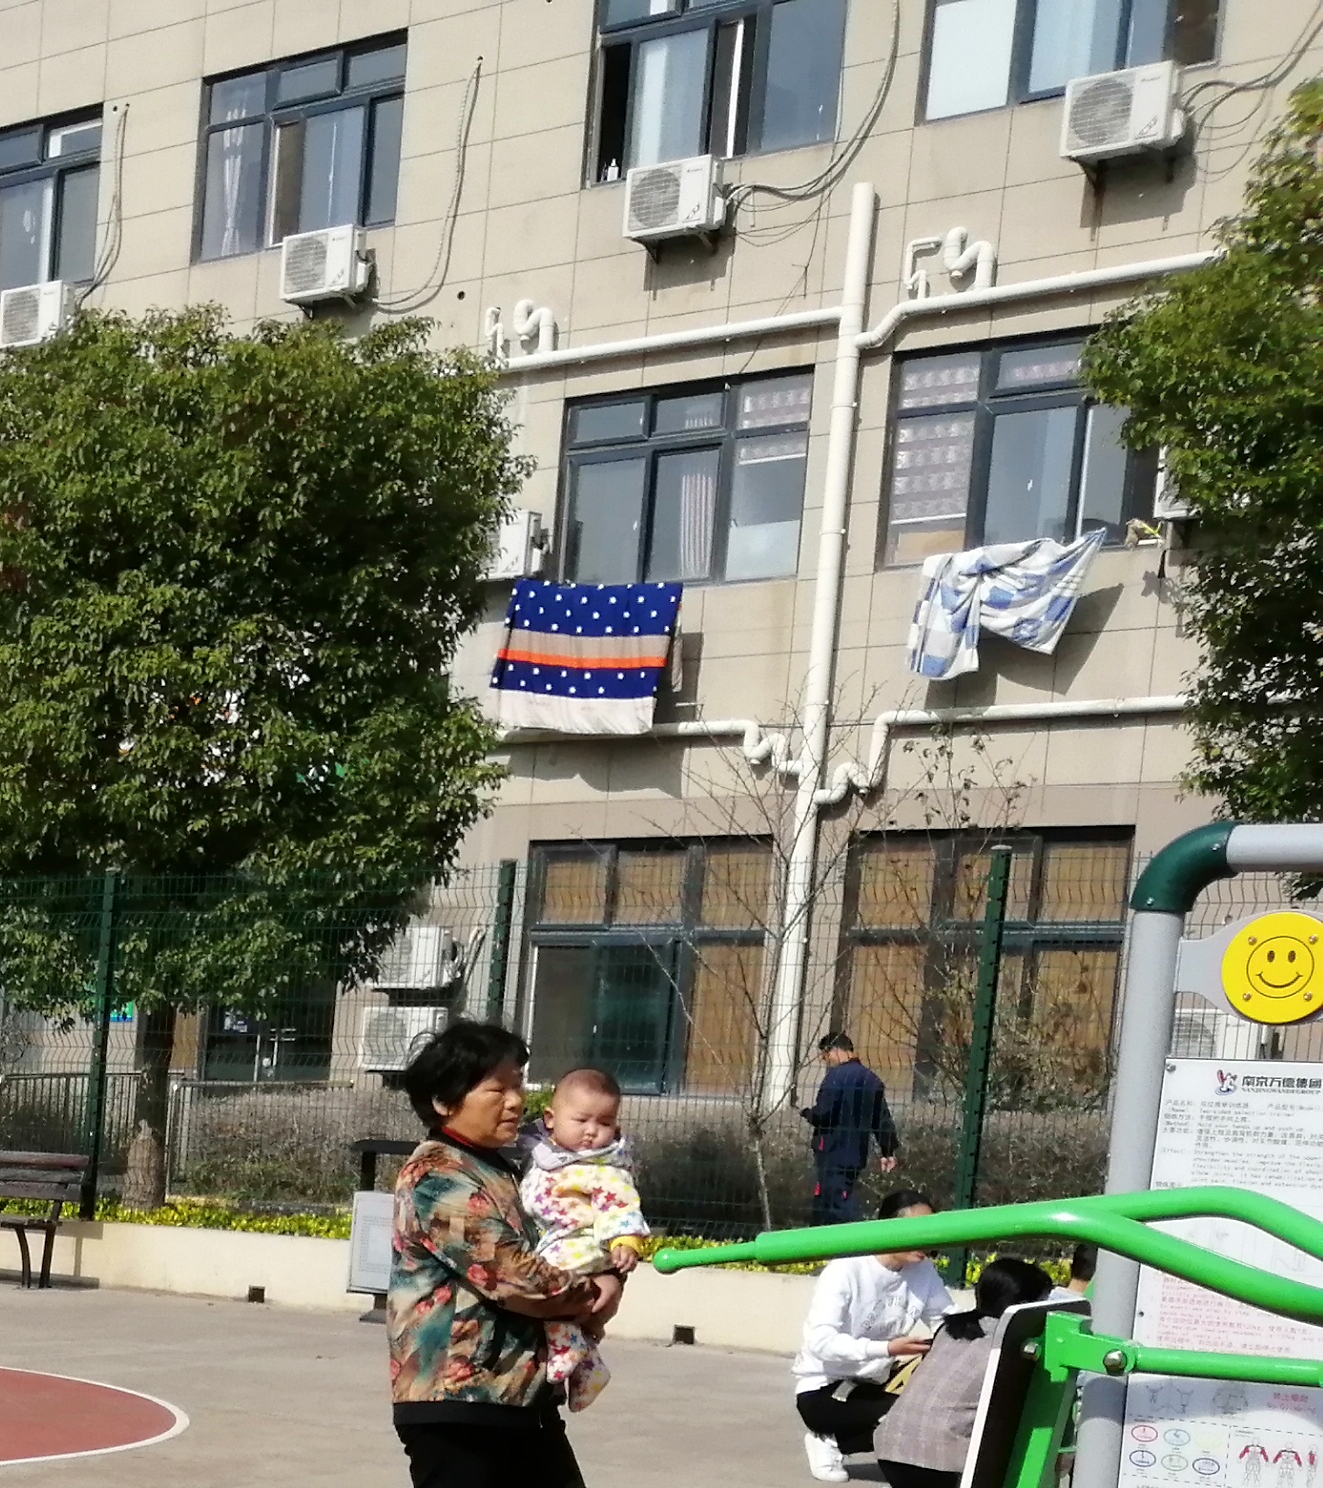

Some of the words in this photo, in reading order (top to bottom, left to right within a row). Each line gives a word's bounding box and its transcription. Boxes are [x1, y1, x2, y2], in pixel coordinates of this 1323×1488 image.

[1242, 1075, 1322, 1089] 南京万德集团
